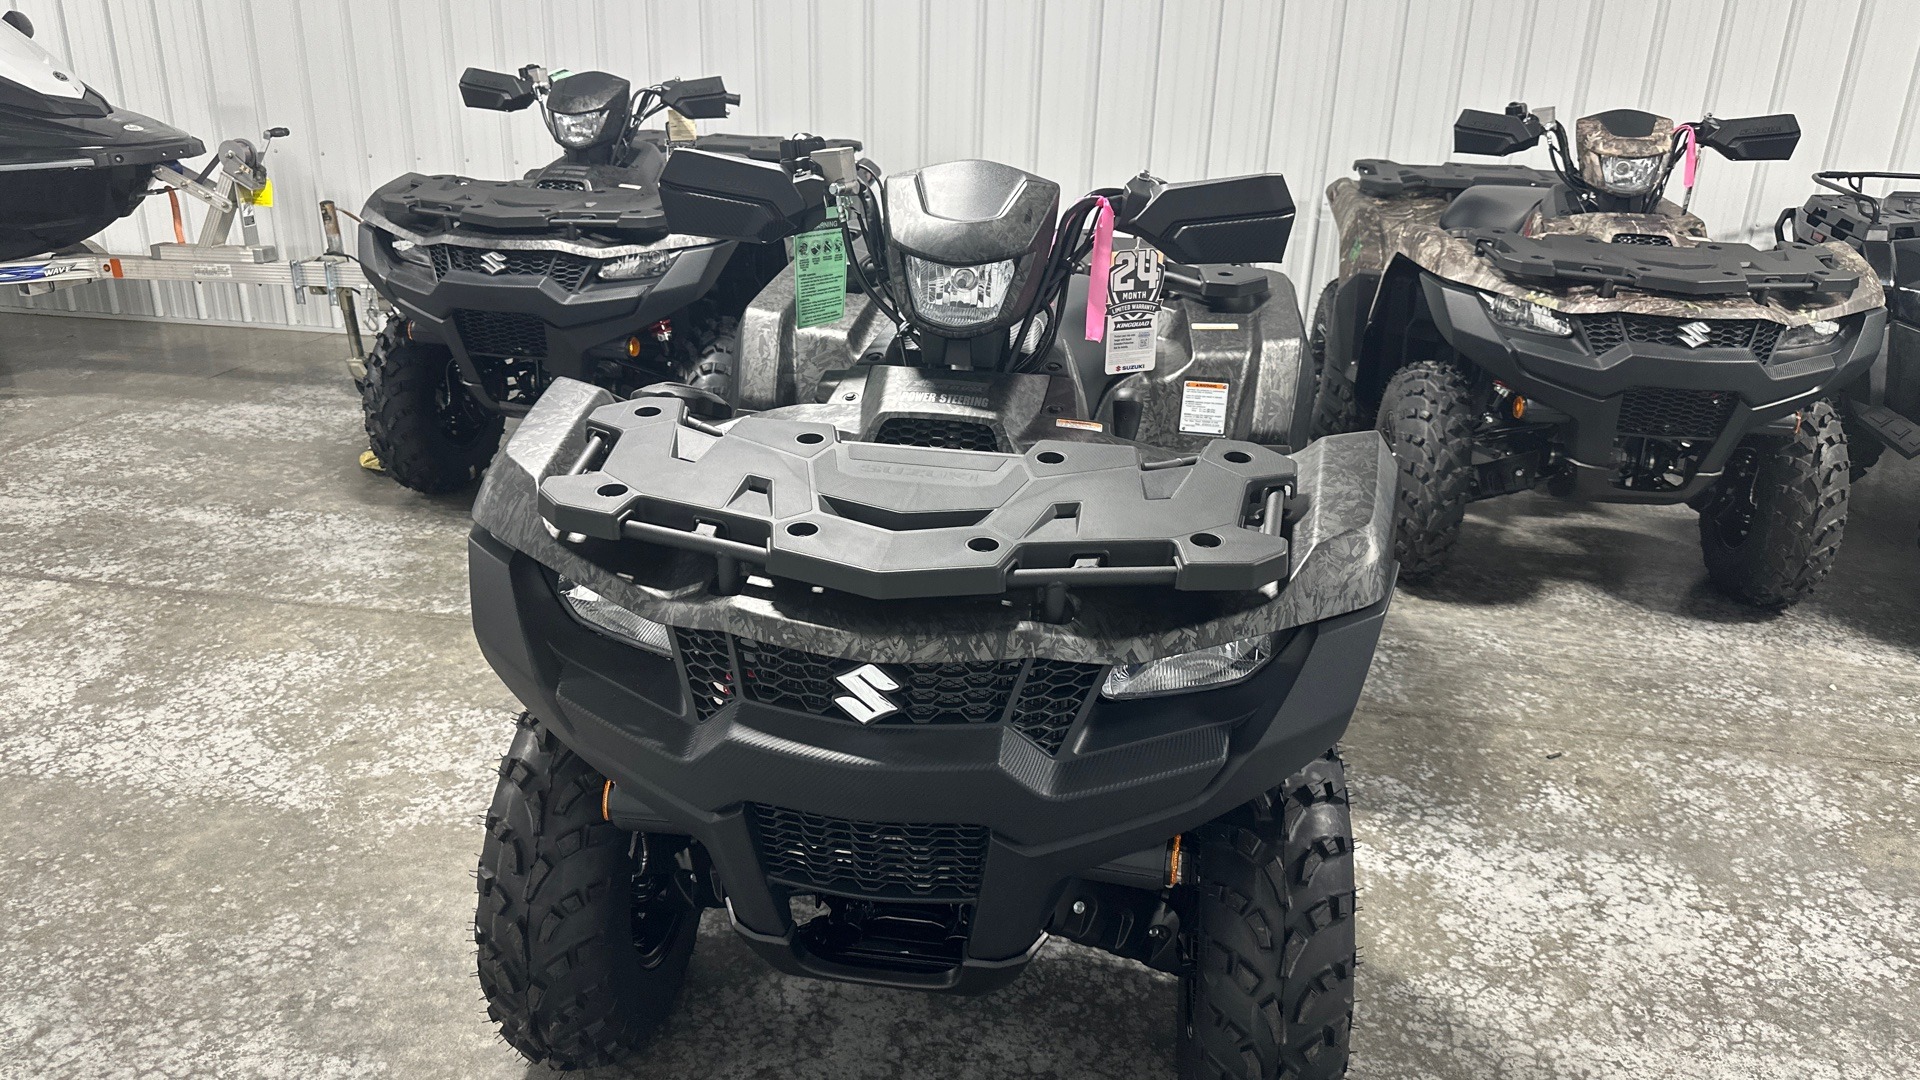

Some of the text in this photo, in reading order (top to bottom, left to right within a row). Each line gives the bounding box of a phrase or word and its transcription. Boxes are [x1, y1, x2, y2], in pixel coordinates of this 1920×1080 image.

[1113, 250, 1159, 291] 24
[1122, 291, 1147, 300] MONTH
[1111, 303, 1157, 315] LIMITED WARRANTY
[1116, 321, 1150, 329] KINGQUAD
[901, 391, 990, 407] POWER STEERING
